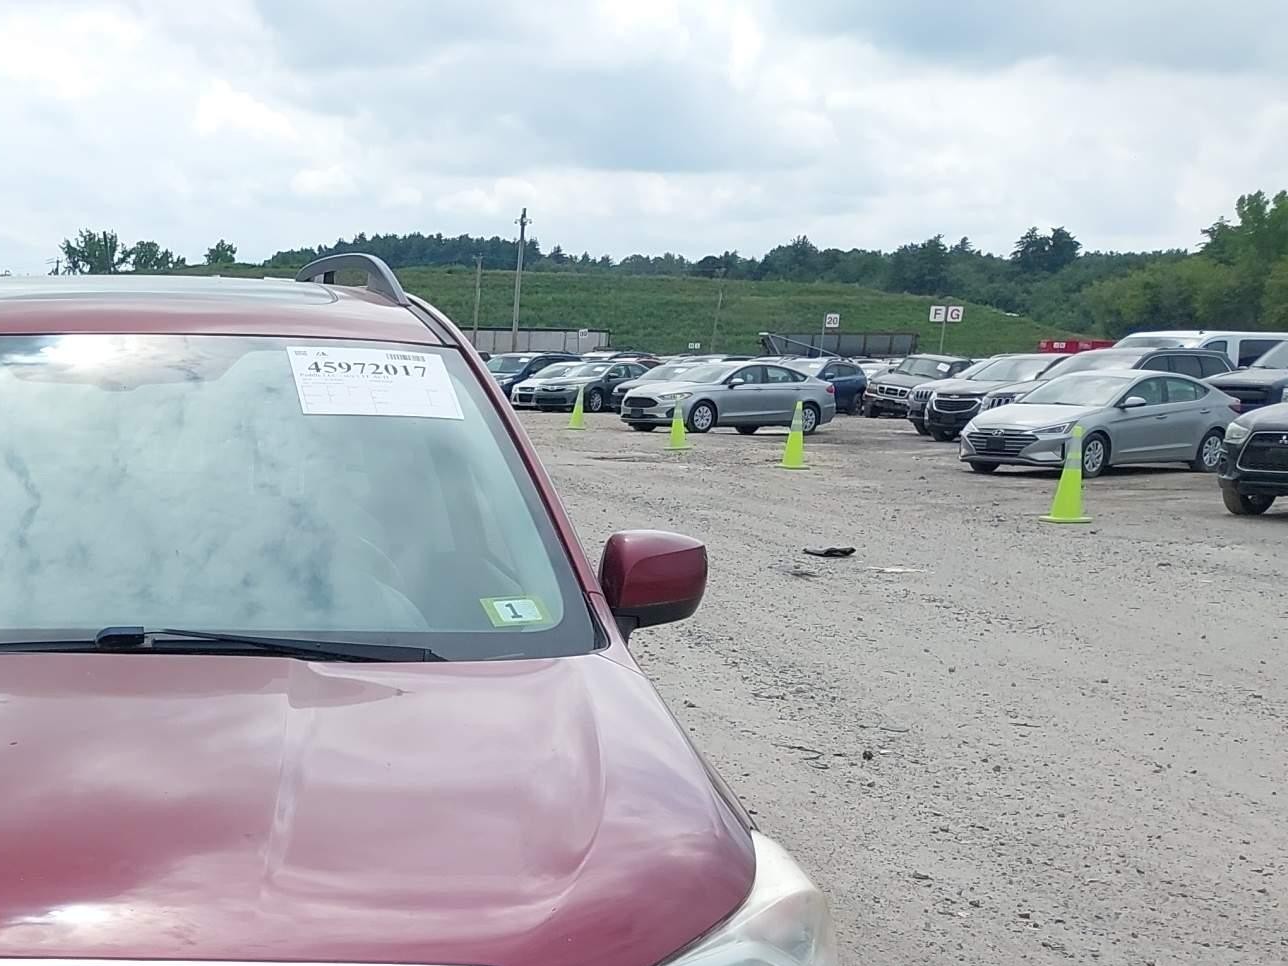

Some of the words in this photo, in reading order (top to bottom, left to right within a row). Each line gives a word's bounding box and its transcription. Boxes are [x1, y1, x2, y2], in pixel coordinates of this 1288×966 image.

[826, 316, 838, 325] 20
[933, 308, 943, 319] F
[950, 308, 961, 320] G
[307, 361, 427, 378] 45972017
[505, 602, 523, 619] 1
